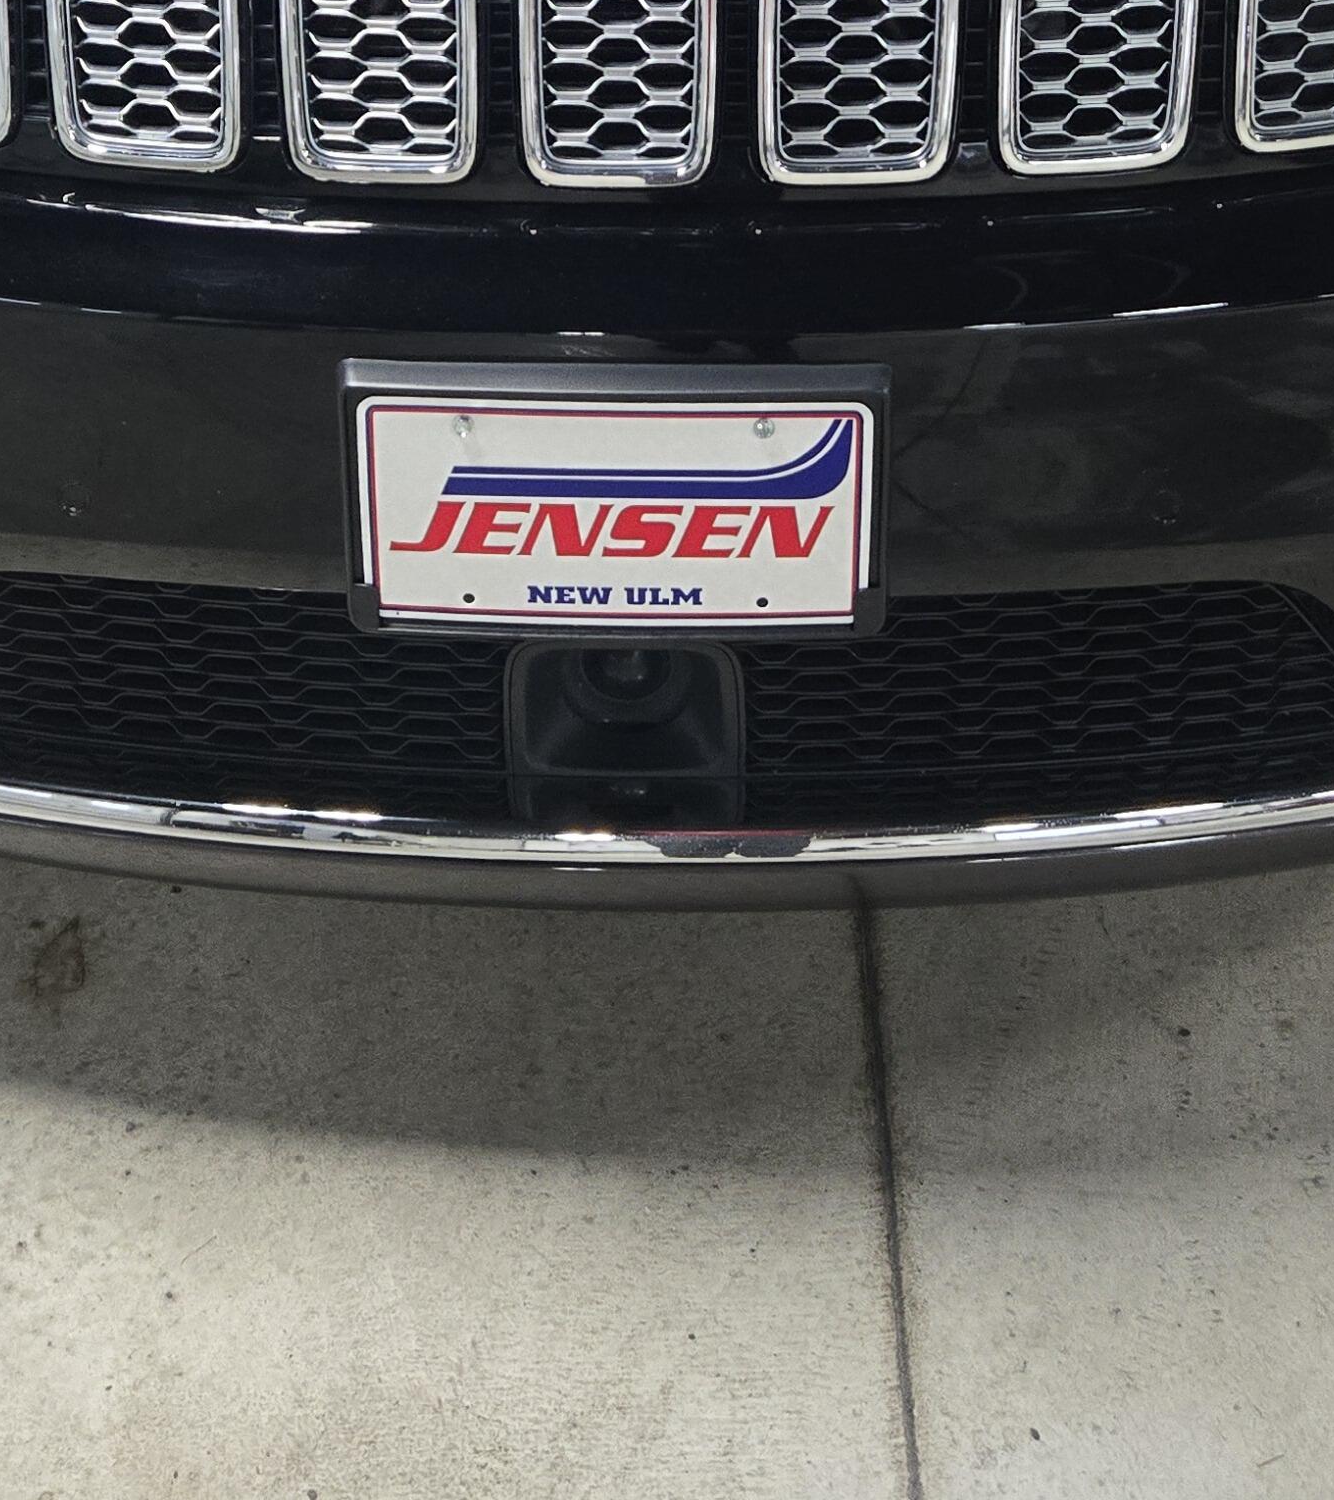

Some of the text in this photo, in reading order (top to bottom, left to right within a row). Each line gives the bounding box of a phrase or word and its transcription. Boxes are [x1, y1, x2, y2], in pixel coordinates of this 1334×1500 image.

[389, 501, 834, 558] JENSEN
[528, 585, 703, 606] NEW ULM
